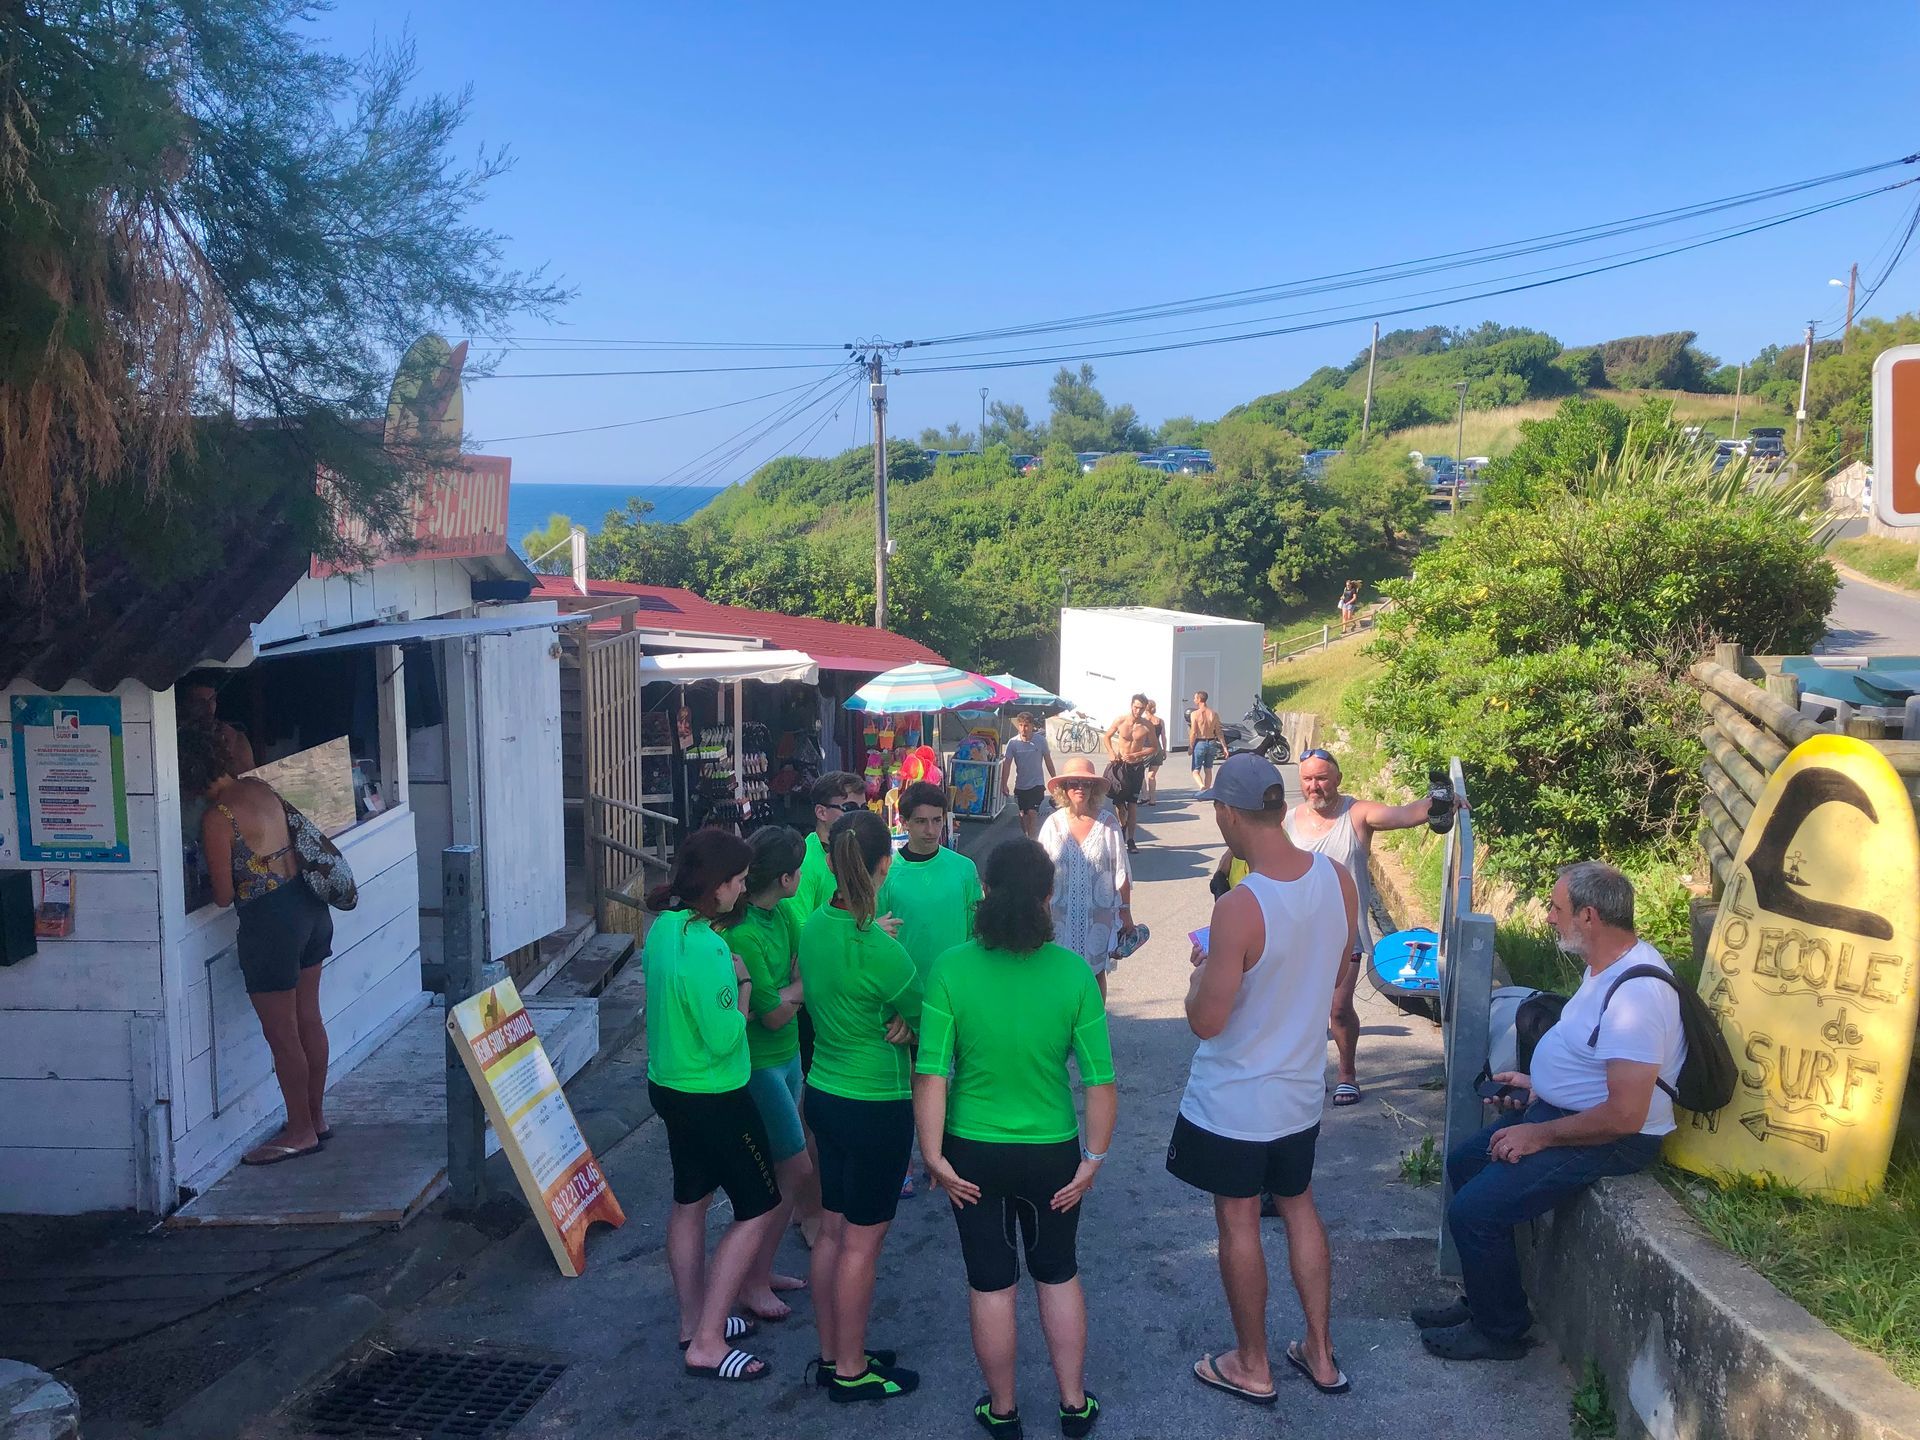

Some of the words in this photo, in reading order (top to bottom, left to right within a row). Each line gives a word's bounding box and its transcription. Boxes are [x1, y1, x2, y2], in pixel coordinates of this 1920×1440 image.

[429, 472, 505, 539] SCHOOL
[1752, 927, 1903, 1004] ECOLE
[1692, 873, 1754, 1134] LOCATN
[488, 1028, 507, 1053] SURF
[503, 1013, 533, 1044] SCHOOL
[1821, 1007, 1864, 1045] de
[1741, 1030, 1880, 1110] SURF
[586, 1162, 600, 1184] 46
[742, 1132, 775, 1194] MADNESS
[559, 1189, 573, 1211] 12
[566, 1180, 581, 1204] 21
[573, 1172, 590, 1195] 78
[551, 1196, 566, 1220] 06
